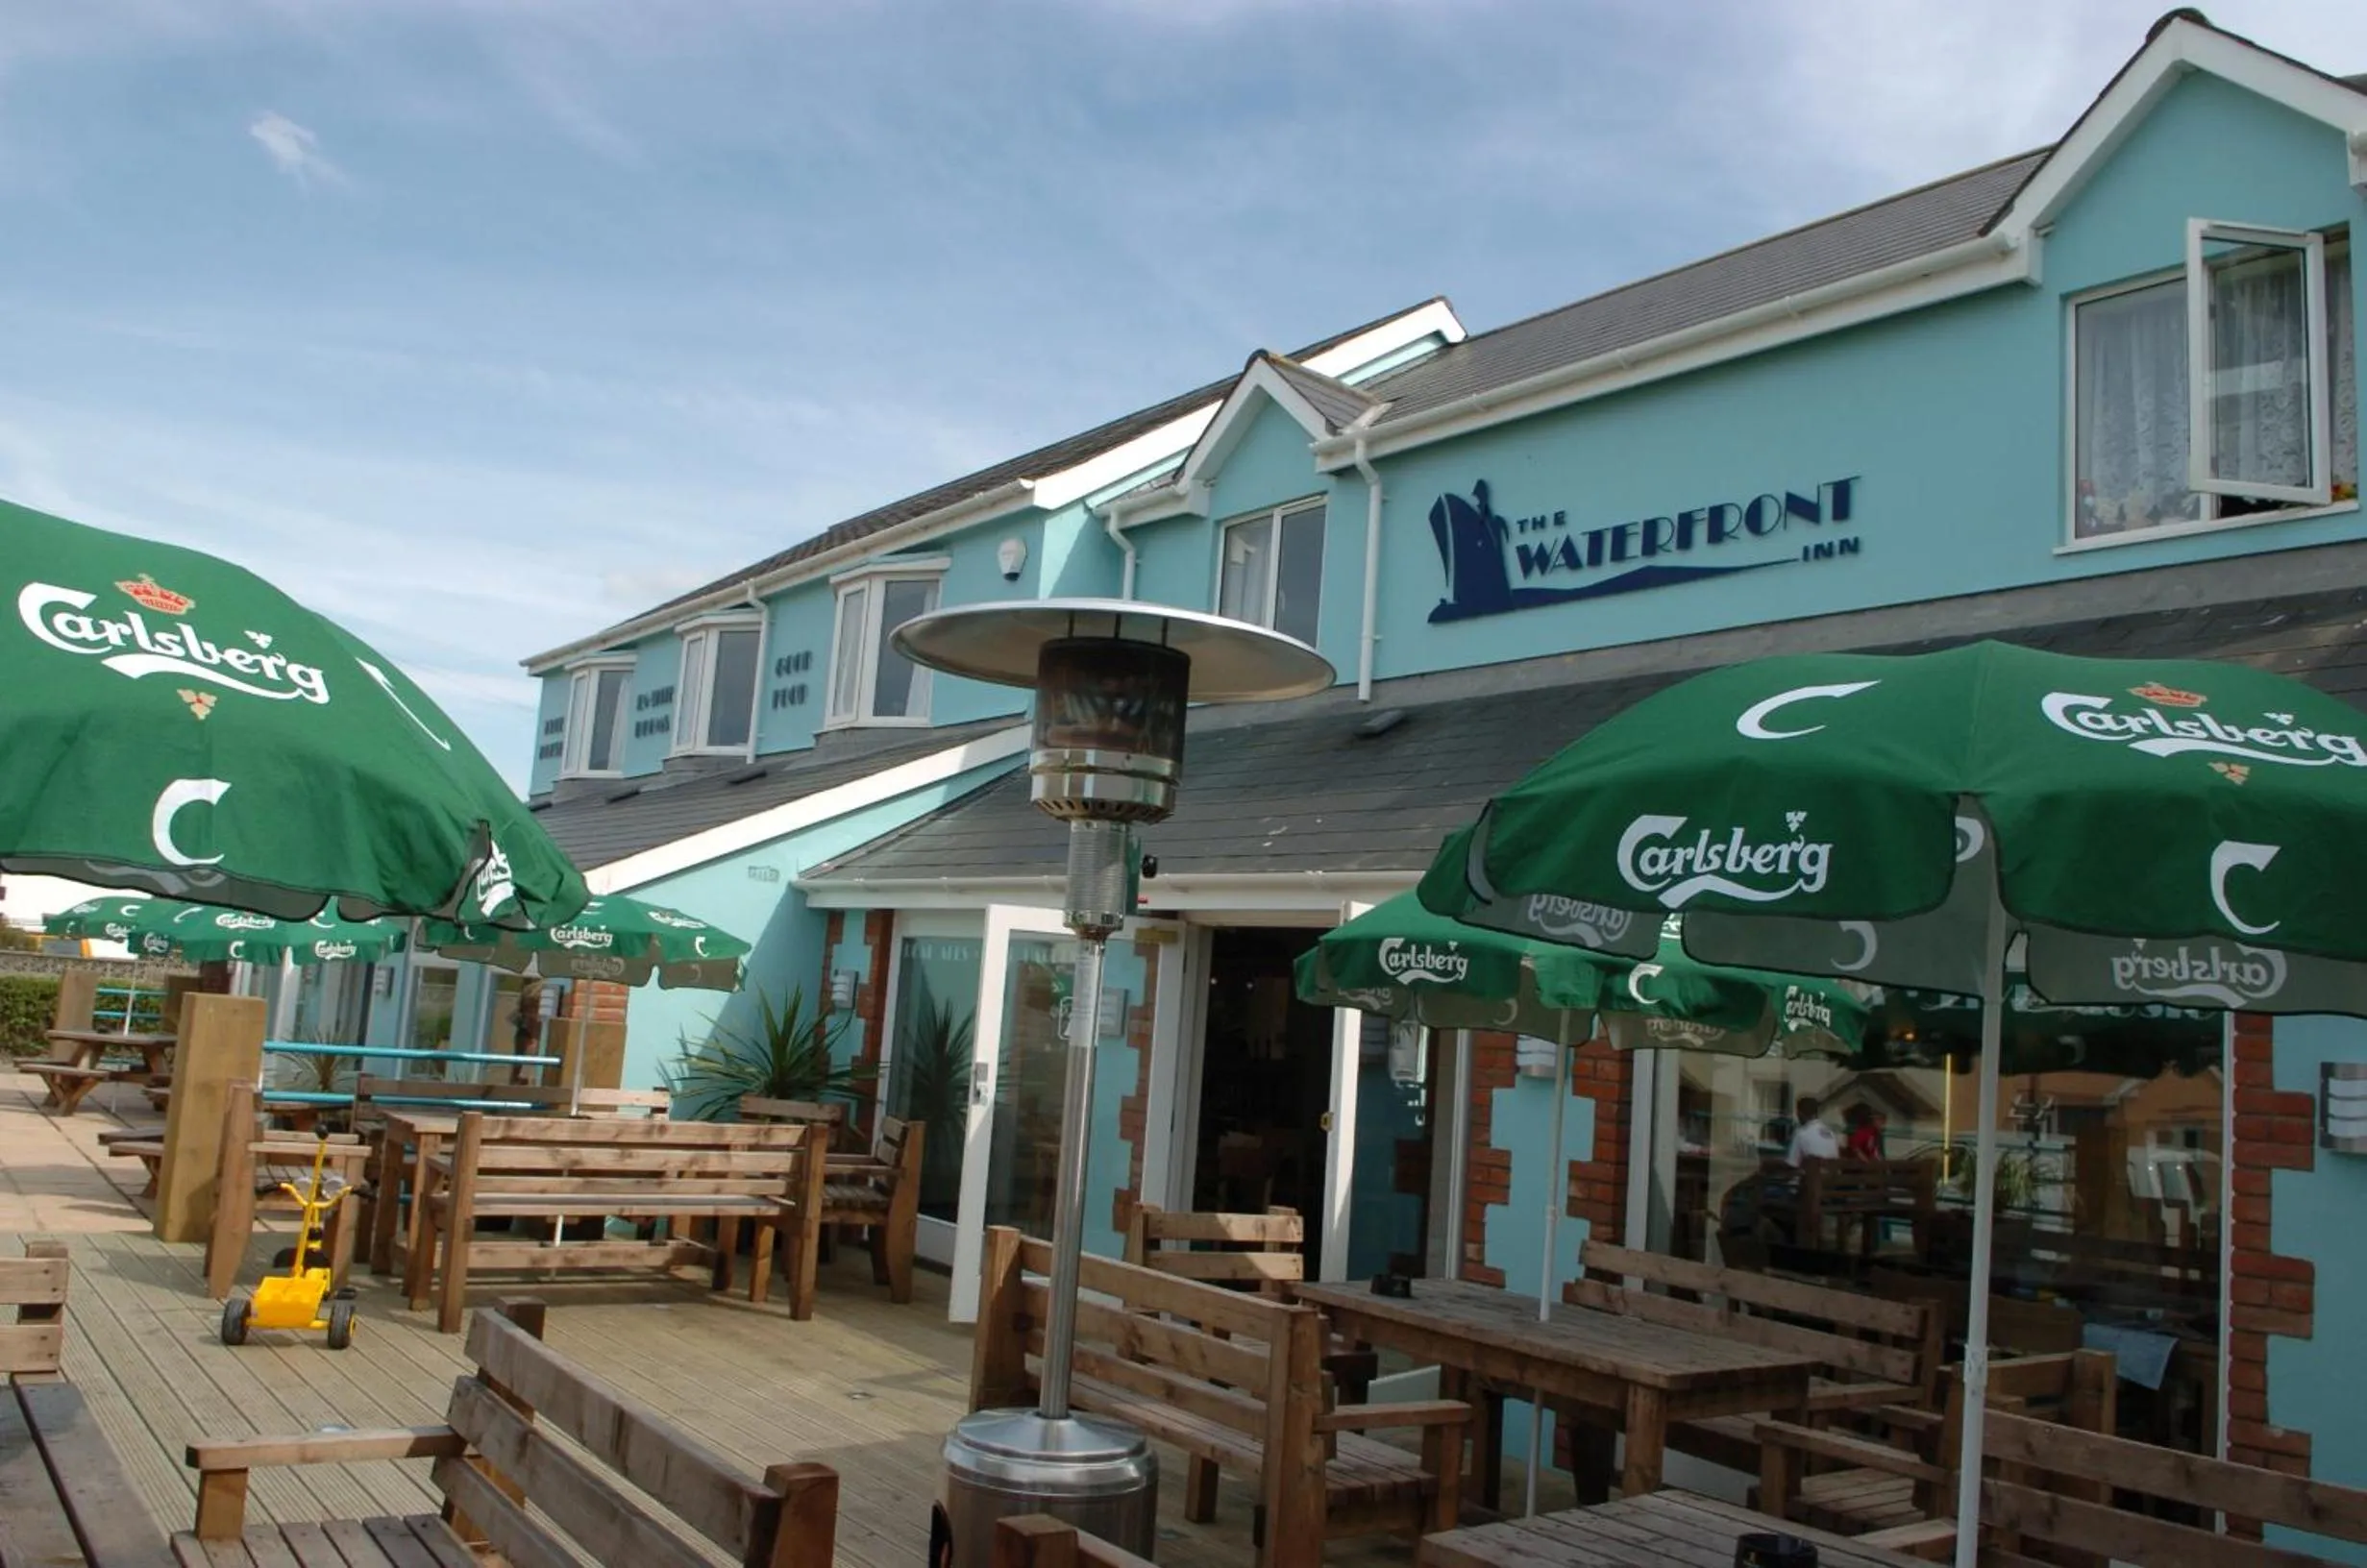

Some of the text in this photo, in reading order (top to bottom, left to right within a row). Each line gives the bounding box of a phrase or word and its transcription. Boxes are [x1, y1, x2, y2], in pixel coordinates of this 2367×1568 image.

[1516, 509, 1567, 534] THE
[1516, 475, 1862, 580] WATERFRONT
[1802, 535, 1861, 563] INN
[17, 581, 331, 704] Carlsberg
[1737, 679, 1882, 740] C
[2041, 691, 2367, 766] Carlsberg
[153, 778, 232, 865] C
[1617, 812, 1834, 909] Carlsberg
[2211, 840, 2281, 935] C
[551, 924, 613, 948] Carlsberg
[1379, 938, 1468, 986] Carlsberg
[1628, 963, 1664, 1004] C
